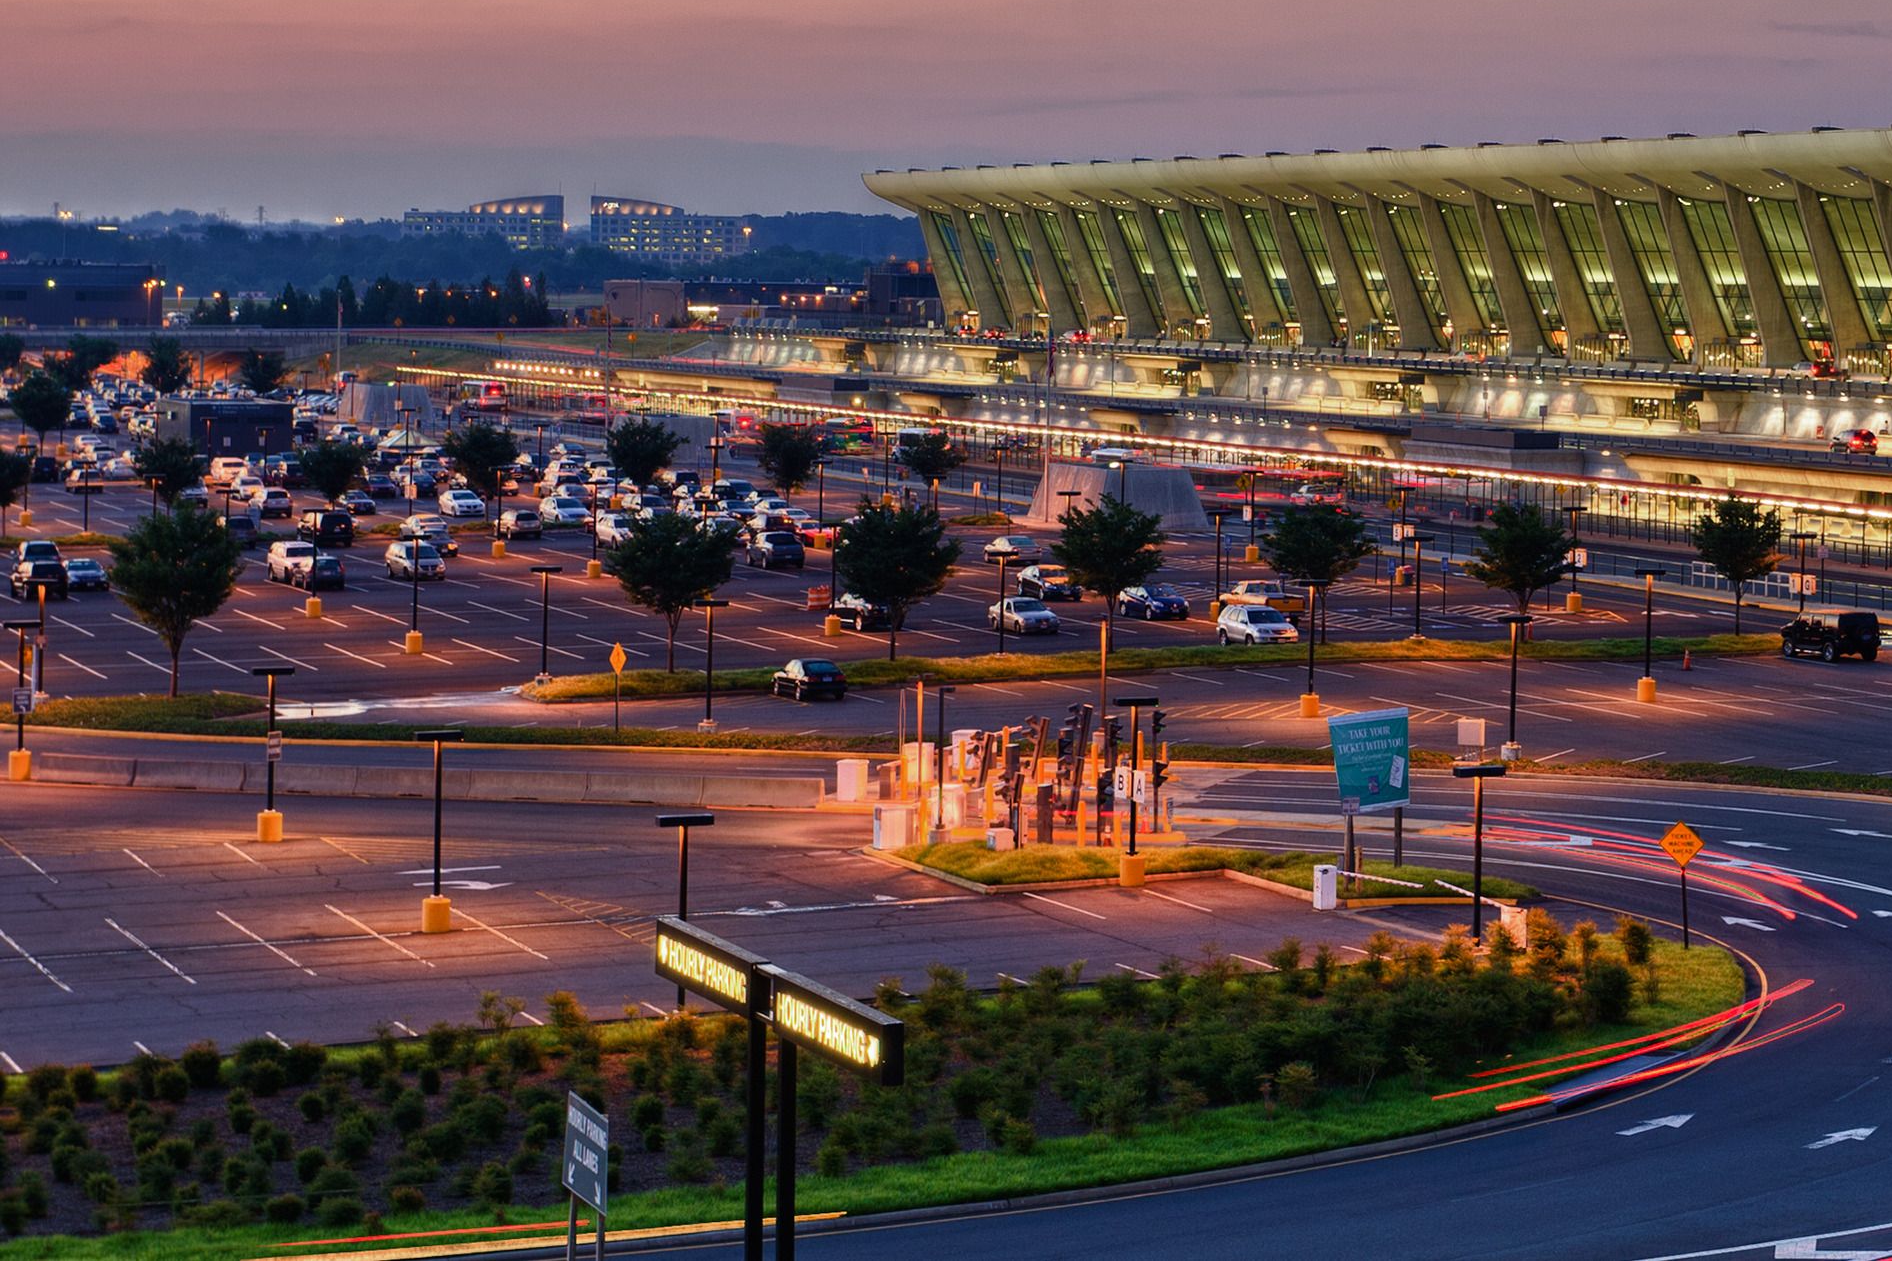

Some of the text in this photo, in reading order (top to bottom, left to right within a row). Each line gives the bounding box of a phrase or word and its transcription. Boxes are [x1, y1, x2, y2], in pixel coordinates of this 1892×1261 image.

[1338, 737, 1404, 755] TICKET WITH YOU
[1349, 725, 1391, 740] TAKE YOUR
[1118, 774, 1124, 790] B
[1136, 778, 1143, 795] A
[668, 939, 747, 1004] HOURLY PARKING
[776, 991, 866, 1061] HOURLY PARKING
[568, 1105, 607, 1151] HOURLY PARKING
[573, 1138, 599, 1174] ALL LANES
